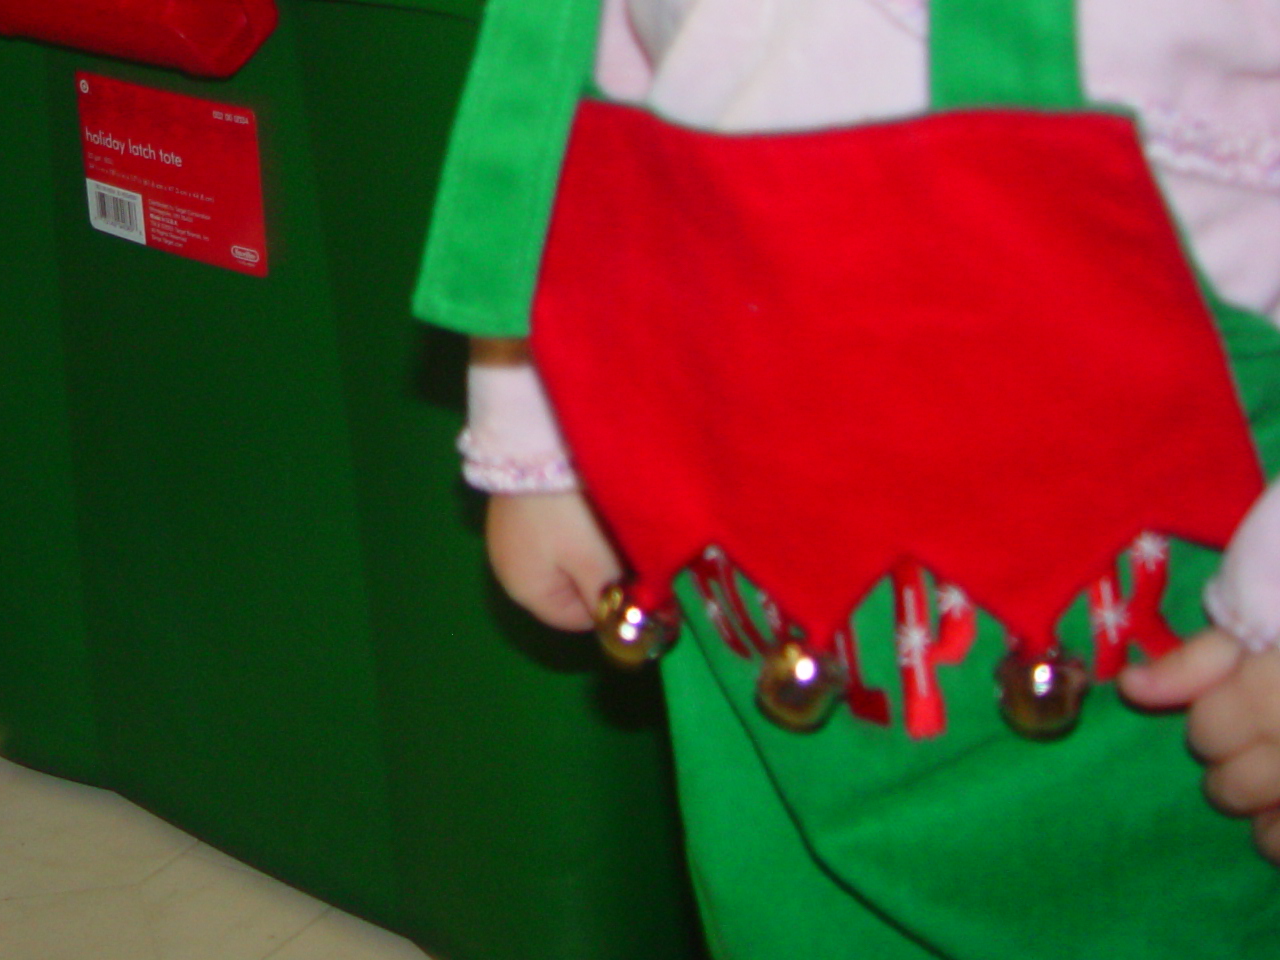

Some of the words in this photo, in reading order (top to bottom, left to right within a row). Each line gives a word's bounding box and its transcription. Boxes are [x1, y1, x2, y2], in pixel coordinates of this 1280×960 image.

[86, 126, 125, 155] holiday
[128, 138, 156, 160] latch
[159, 149, 182, 167] tote
